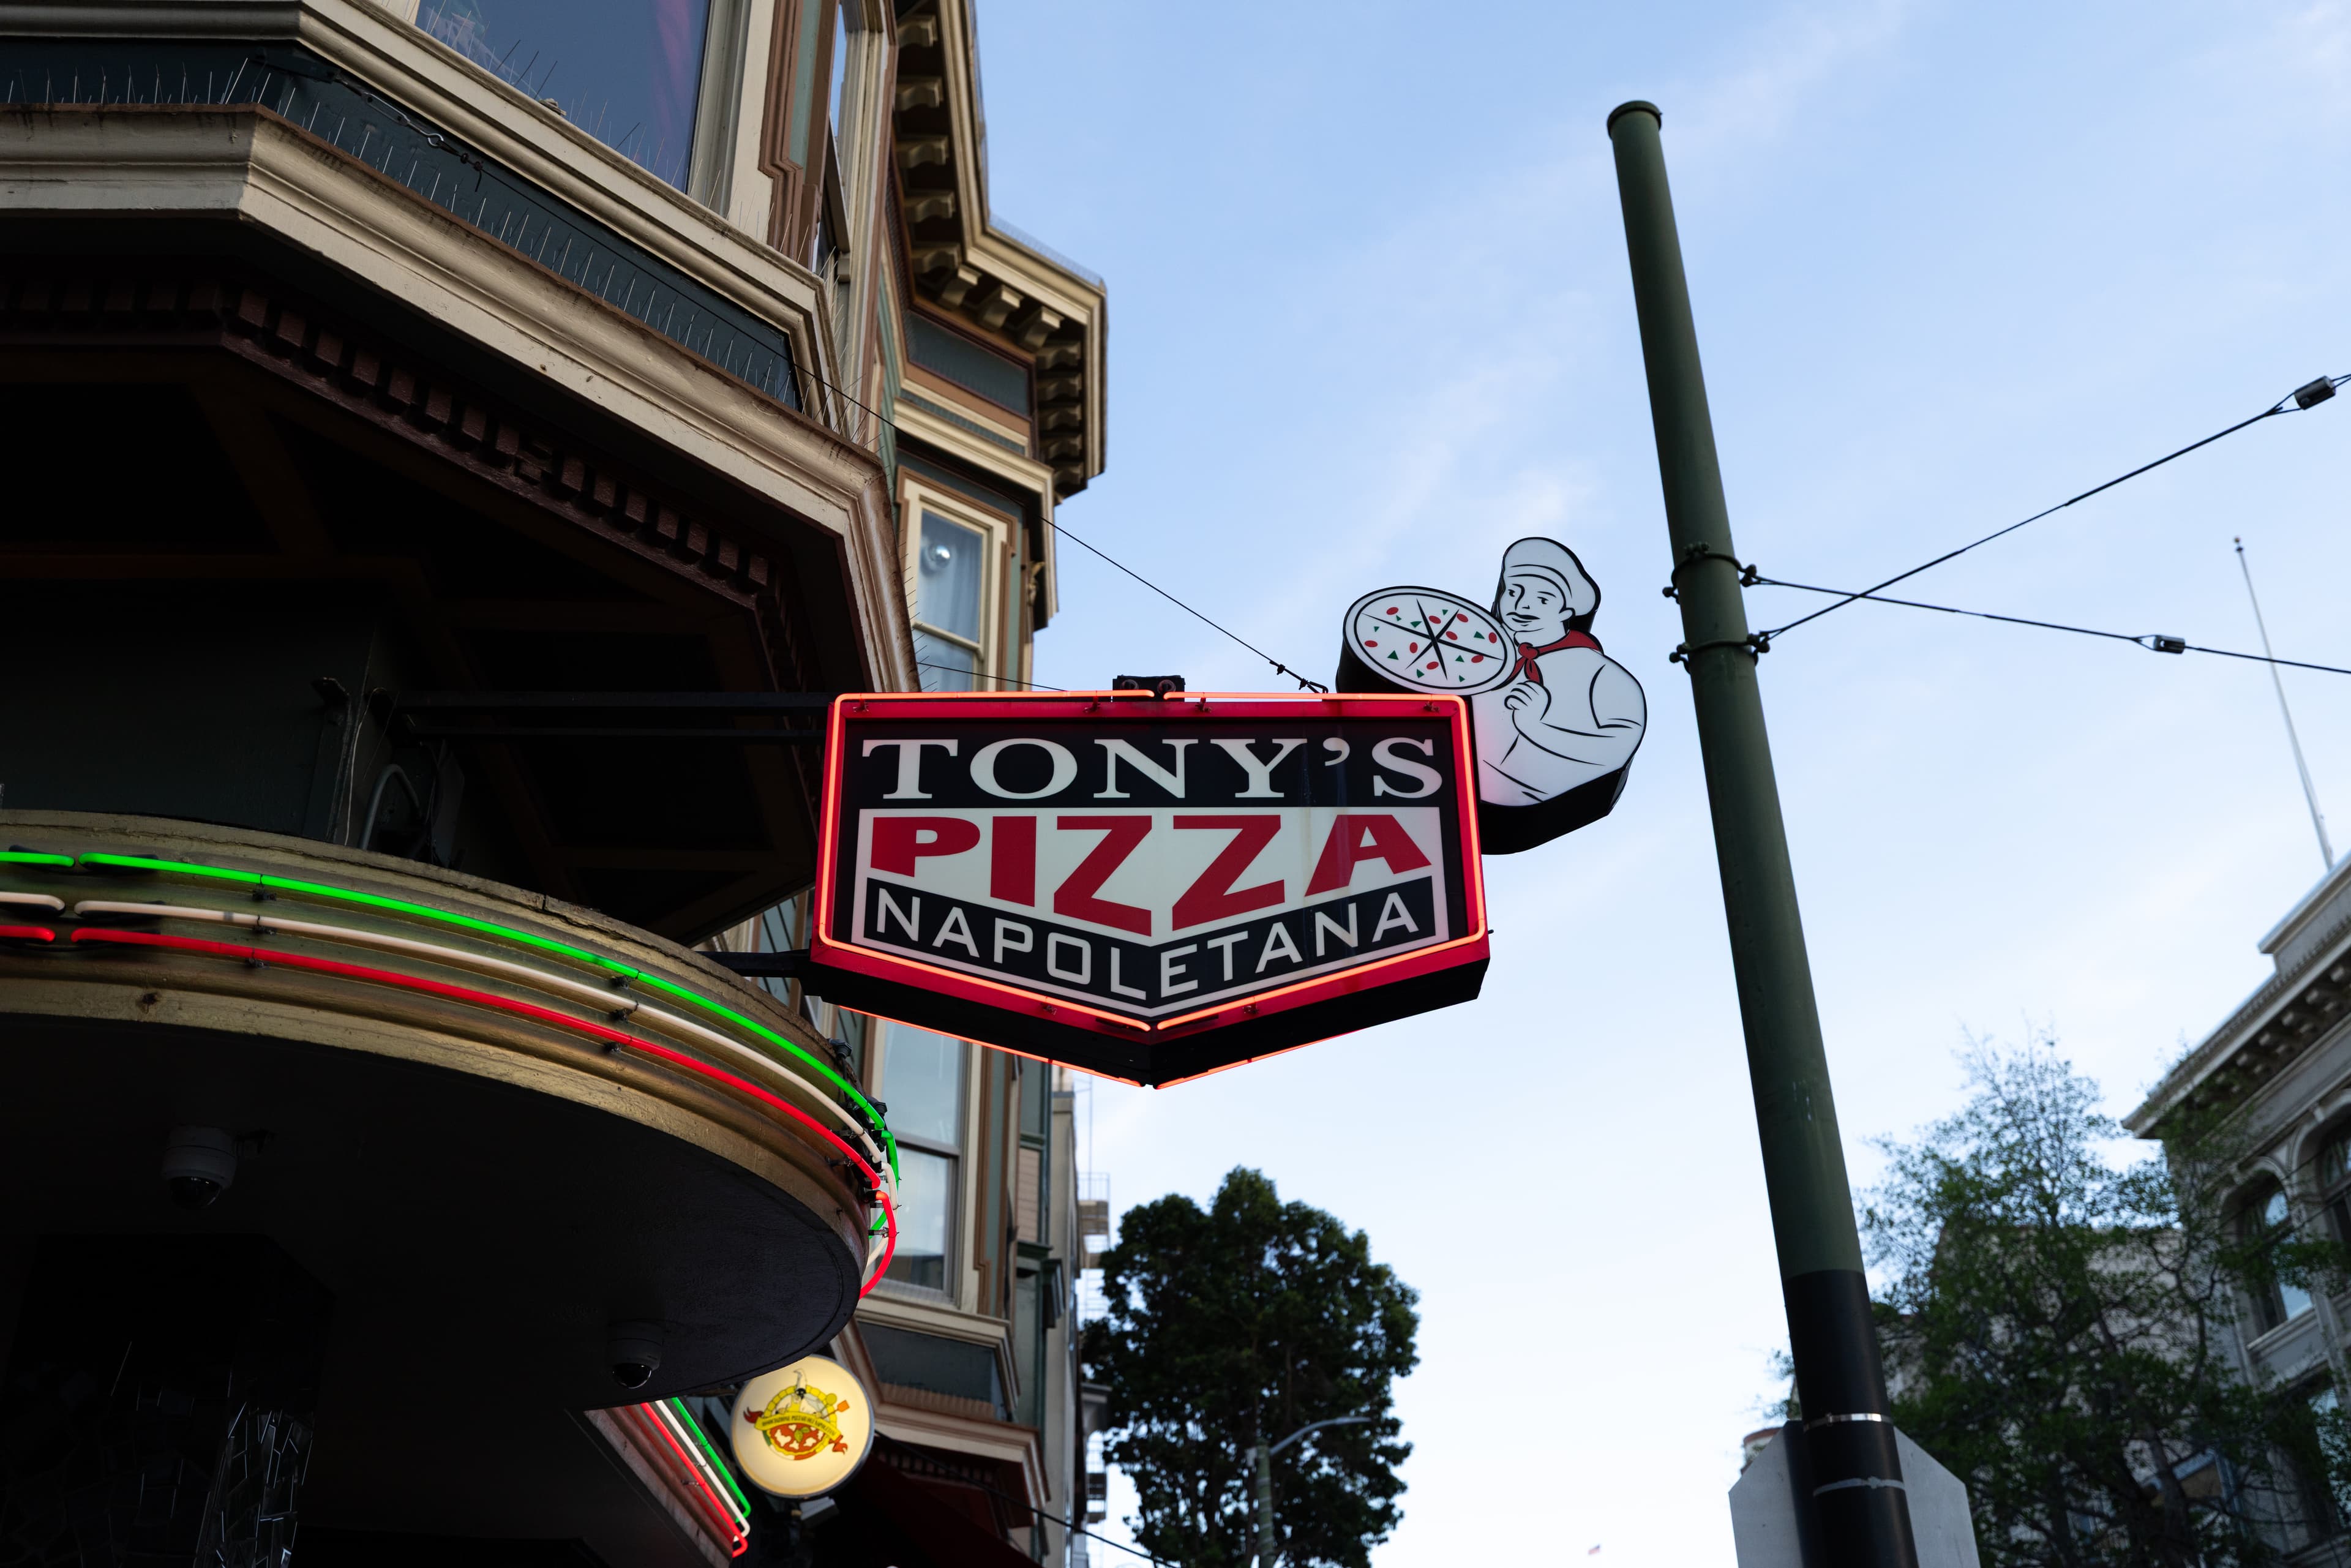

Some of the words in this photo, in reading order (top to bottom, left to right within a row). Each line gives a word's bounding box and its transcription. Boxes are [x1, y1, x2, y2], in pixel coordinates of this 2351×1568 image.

[863, 737, 1442, 799] TONY'S
[870, 815, 1432, 937] PIZZA
[877, 888, 1419, 1001] NAPOLETANA
